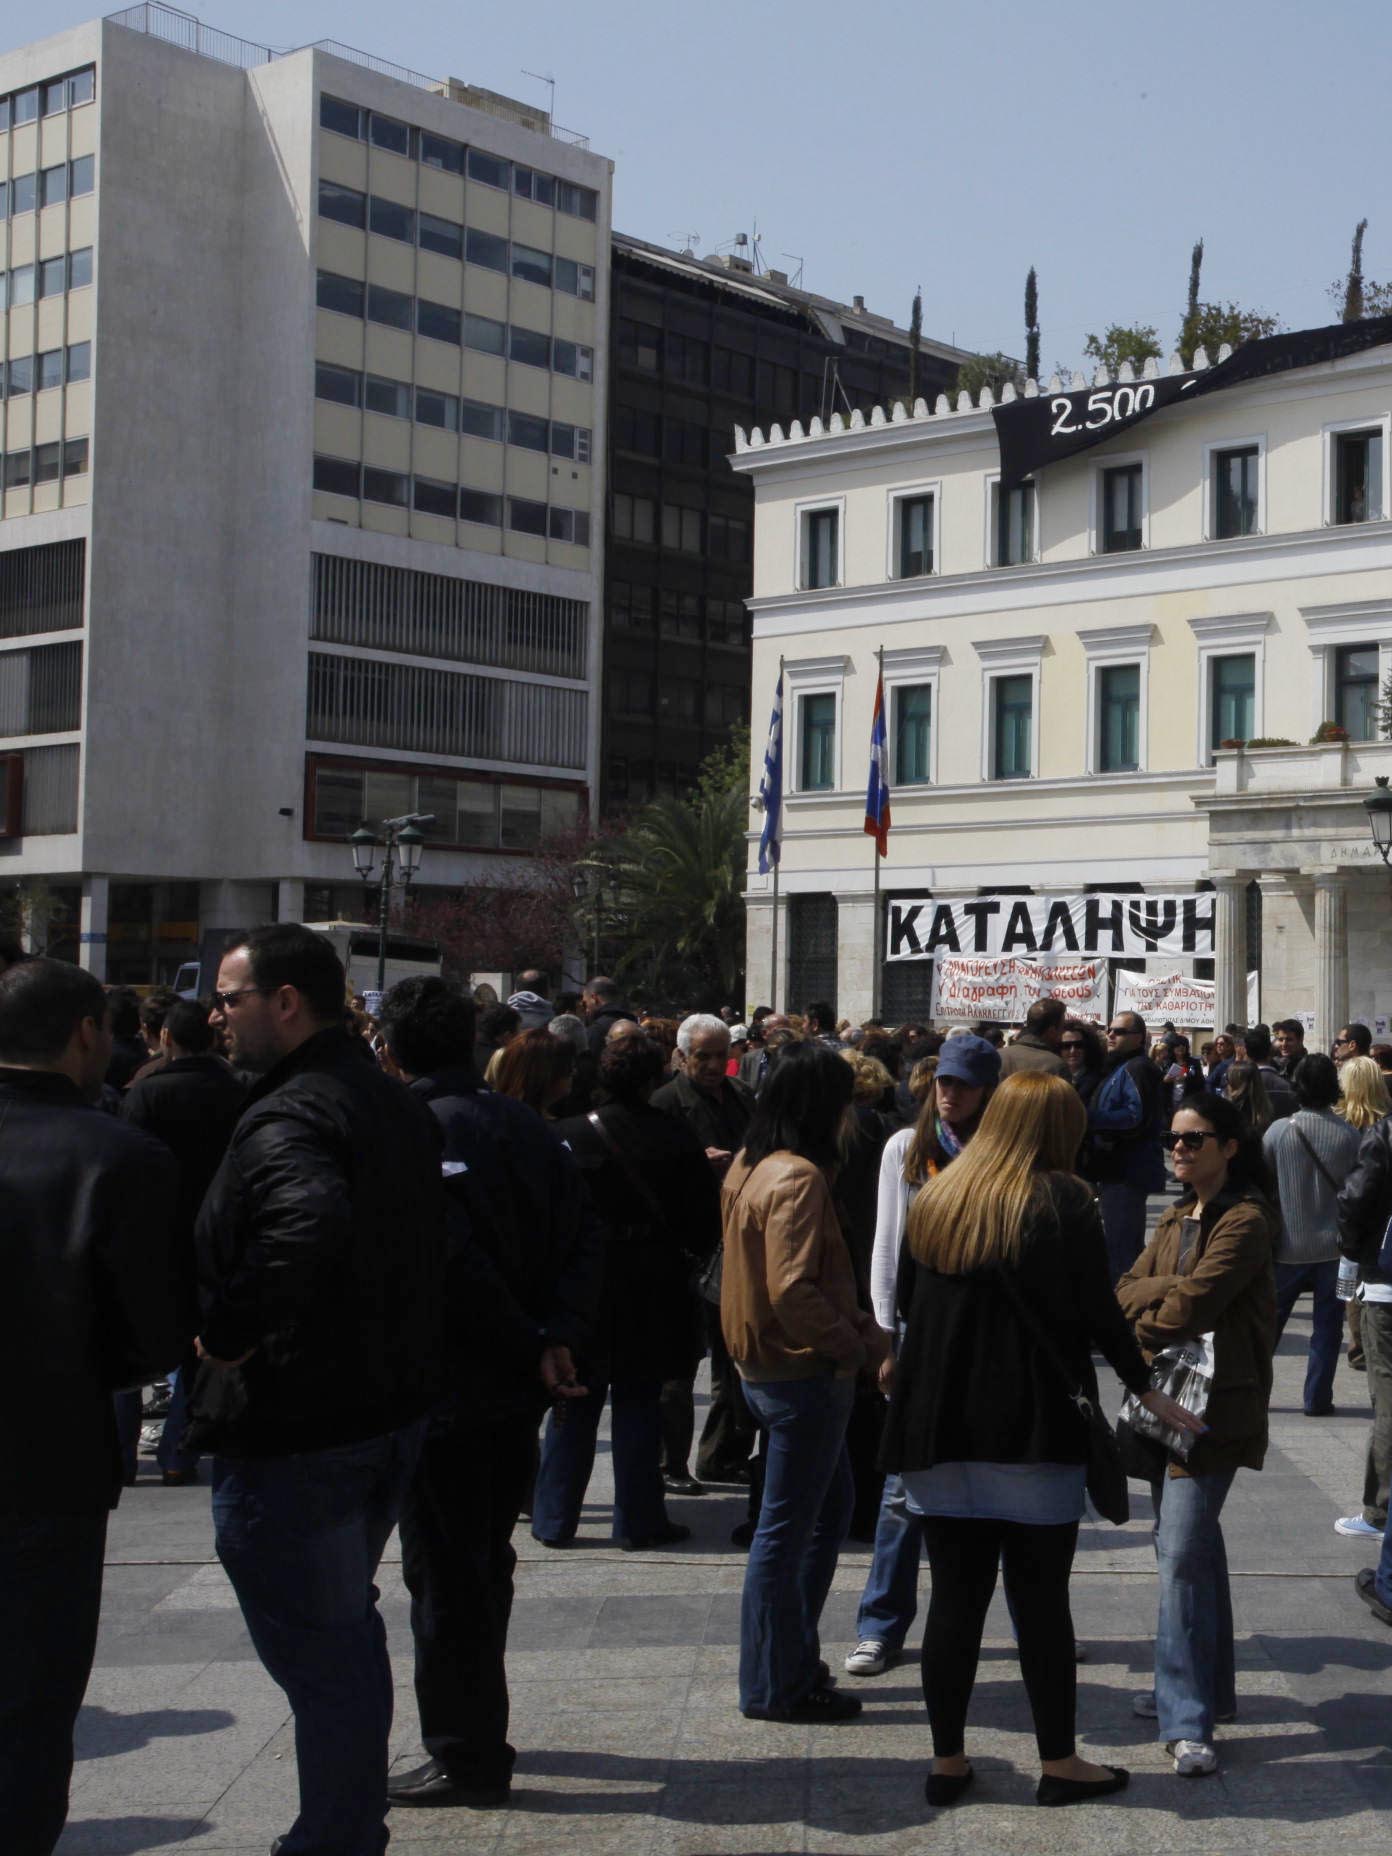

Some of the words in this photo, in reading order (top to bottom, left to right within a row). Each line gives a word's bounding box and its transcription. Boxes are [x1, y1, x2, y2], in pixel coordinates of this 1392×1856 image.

[1050, 384, 1155, 436] 2.500
[891, 898, 1217, 955] ΚΑΤΑΛΗΨΗ
[1137, 988, 1161, 998] ΤΟΥΣ
